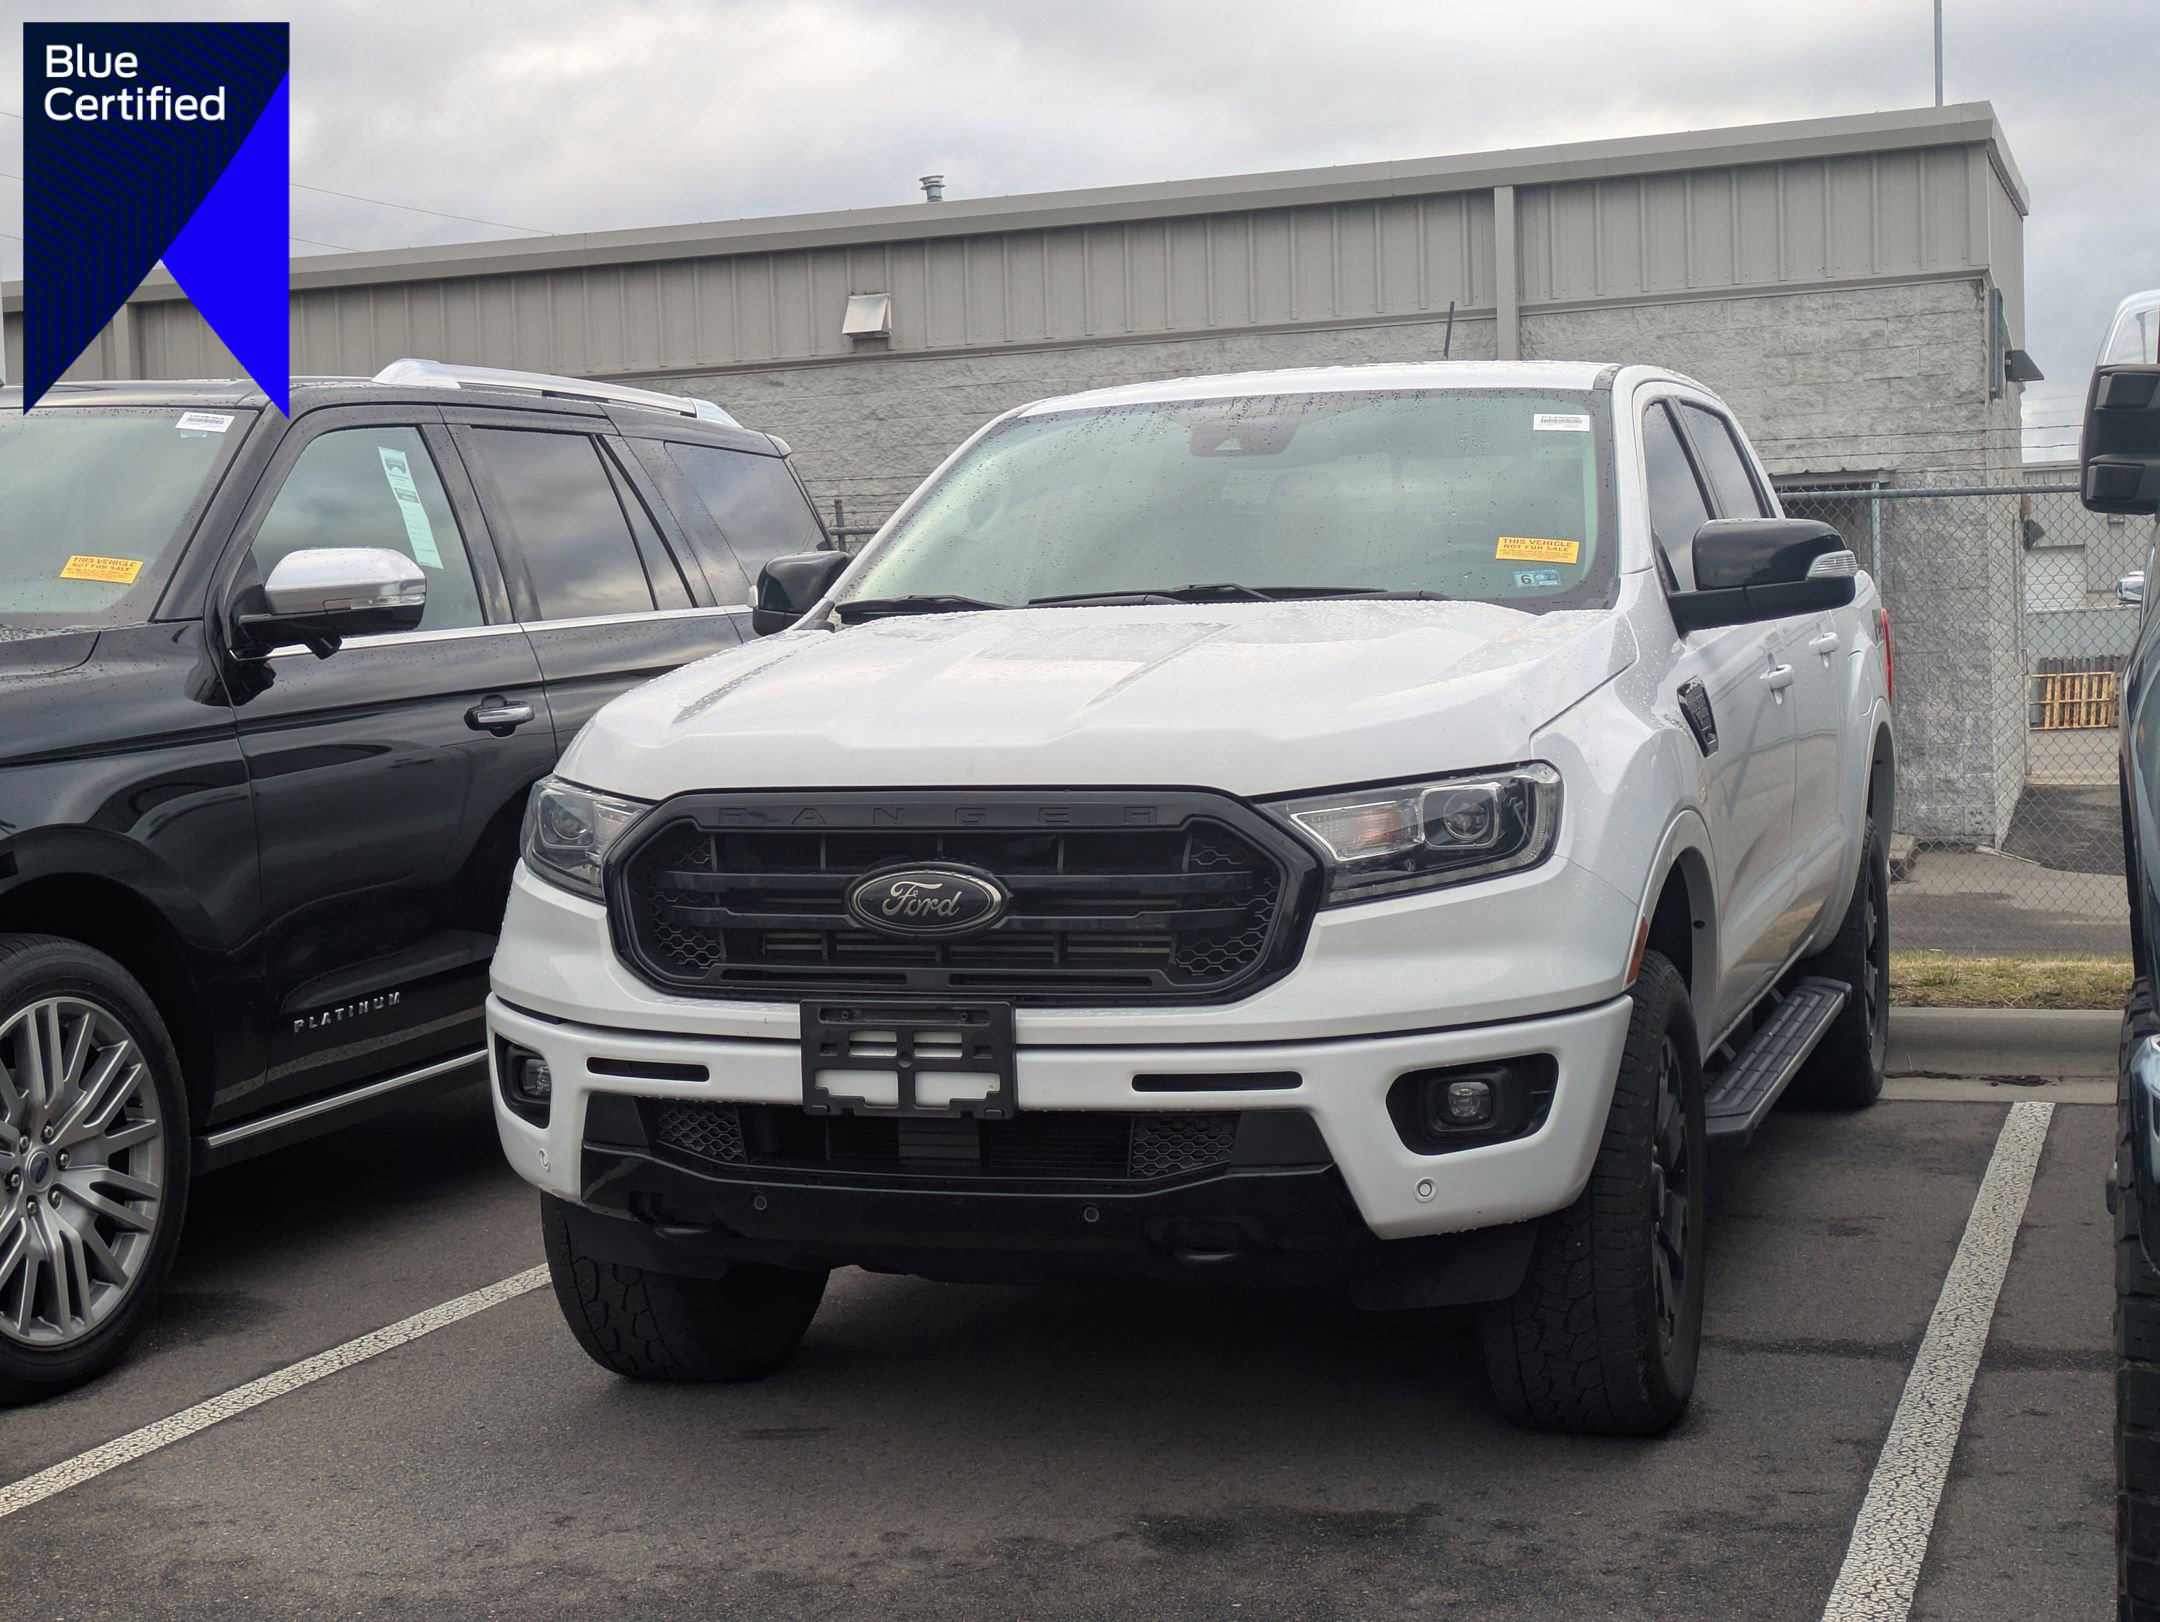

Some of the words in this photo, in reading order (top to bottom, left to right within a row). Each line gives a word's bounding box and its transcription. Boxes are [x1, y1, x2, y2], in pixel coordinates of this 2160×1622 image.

[1529, 539, 1572, 548] VEHICLE
[96, 558, 137, 567] VEHICLE
[1520, 574, 1532, 585] 6
[718, 806, 1158, 825] RANGER
[881, 880, 960, 918] Ford
[293, 991, 400, 1033] PLATINUM
